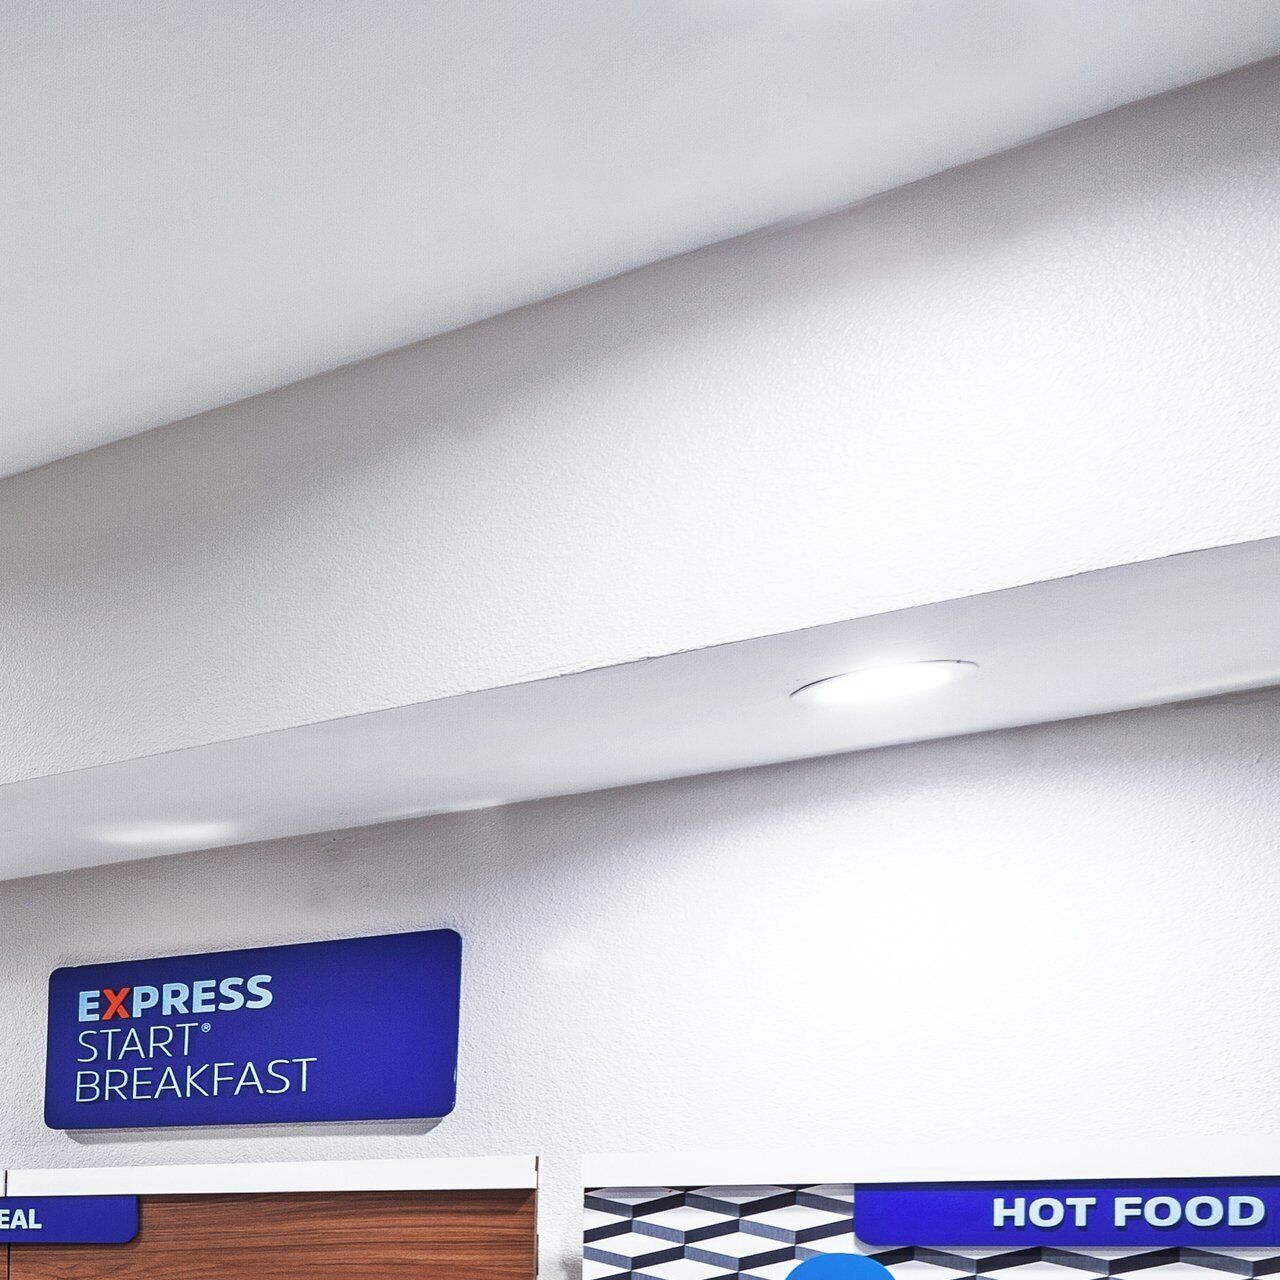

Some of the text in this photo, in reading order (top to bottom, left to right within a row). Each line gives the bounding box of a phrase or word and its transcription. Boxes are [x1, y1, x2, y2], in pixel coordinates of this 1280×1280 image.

[77, 974, 274, 1023] EXPRESS
[75, 1057, 318, 1103] BREAKFAST
[993, 1195, 1266, 1228] HOT FOOD
